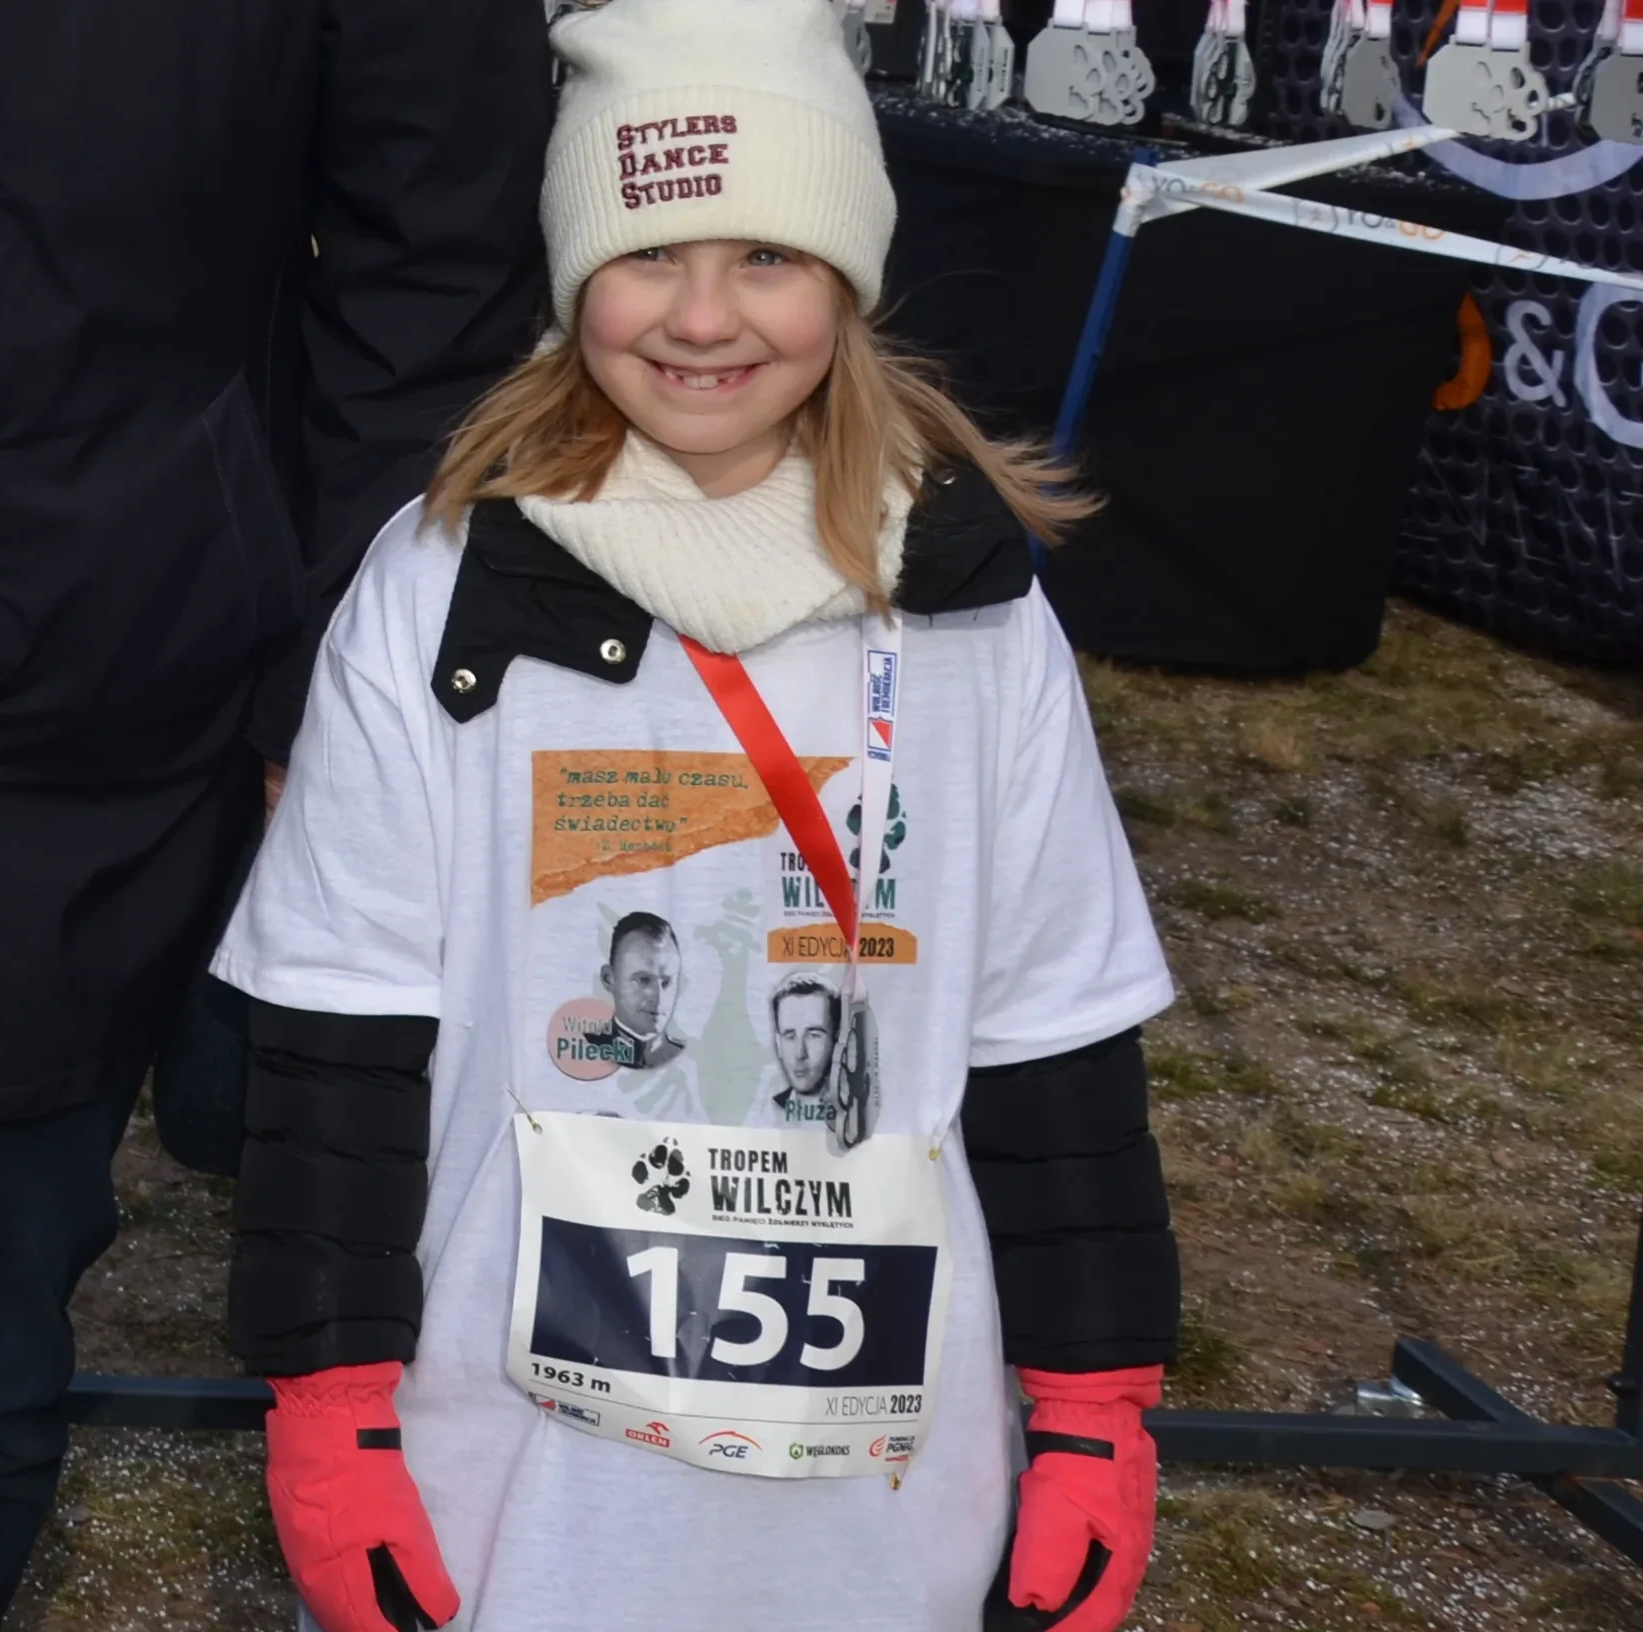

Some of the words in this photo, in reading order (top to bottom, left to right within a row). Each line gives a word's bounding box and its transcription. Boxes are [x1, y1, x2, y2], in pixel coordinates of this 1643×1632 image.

[557, 791, 630, 809] trzeba
[782, 876, 896, 910] WILM
[859, 937, 895, 958] 2023
[557, 1036, 635, 1063] Pilecki
[785, 1098, 837, 1122] Płuża
[708, 1148, 789, 1174] TROPEM
[710, 1175, 853, 1218] WILCZYM
[626, 1245, 866, 1371] 155
[531, 1362, 585, 1387] 1963
[590, 1377, 611, 1393] m
[825, 1398, 838, 1415] XI
[841, 1398, 888, 1416] EDYCJA
[889, 1394, 923, 1414] 2023
[626, 1429, 670, 1448] ORLEN
[708, 1442, 749, 1459] PGE
